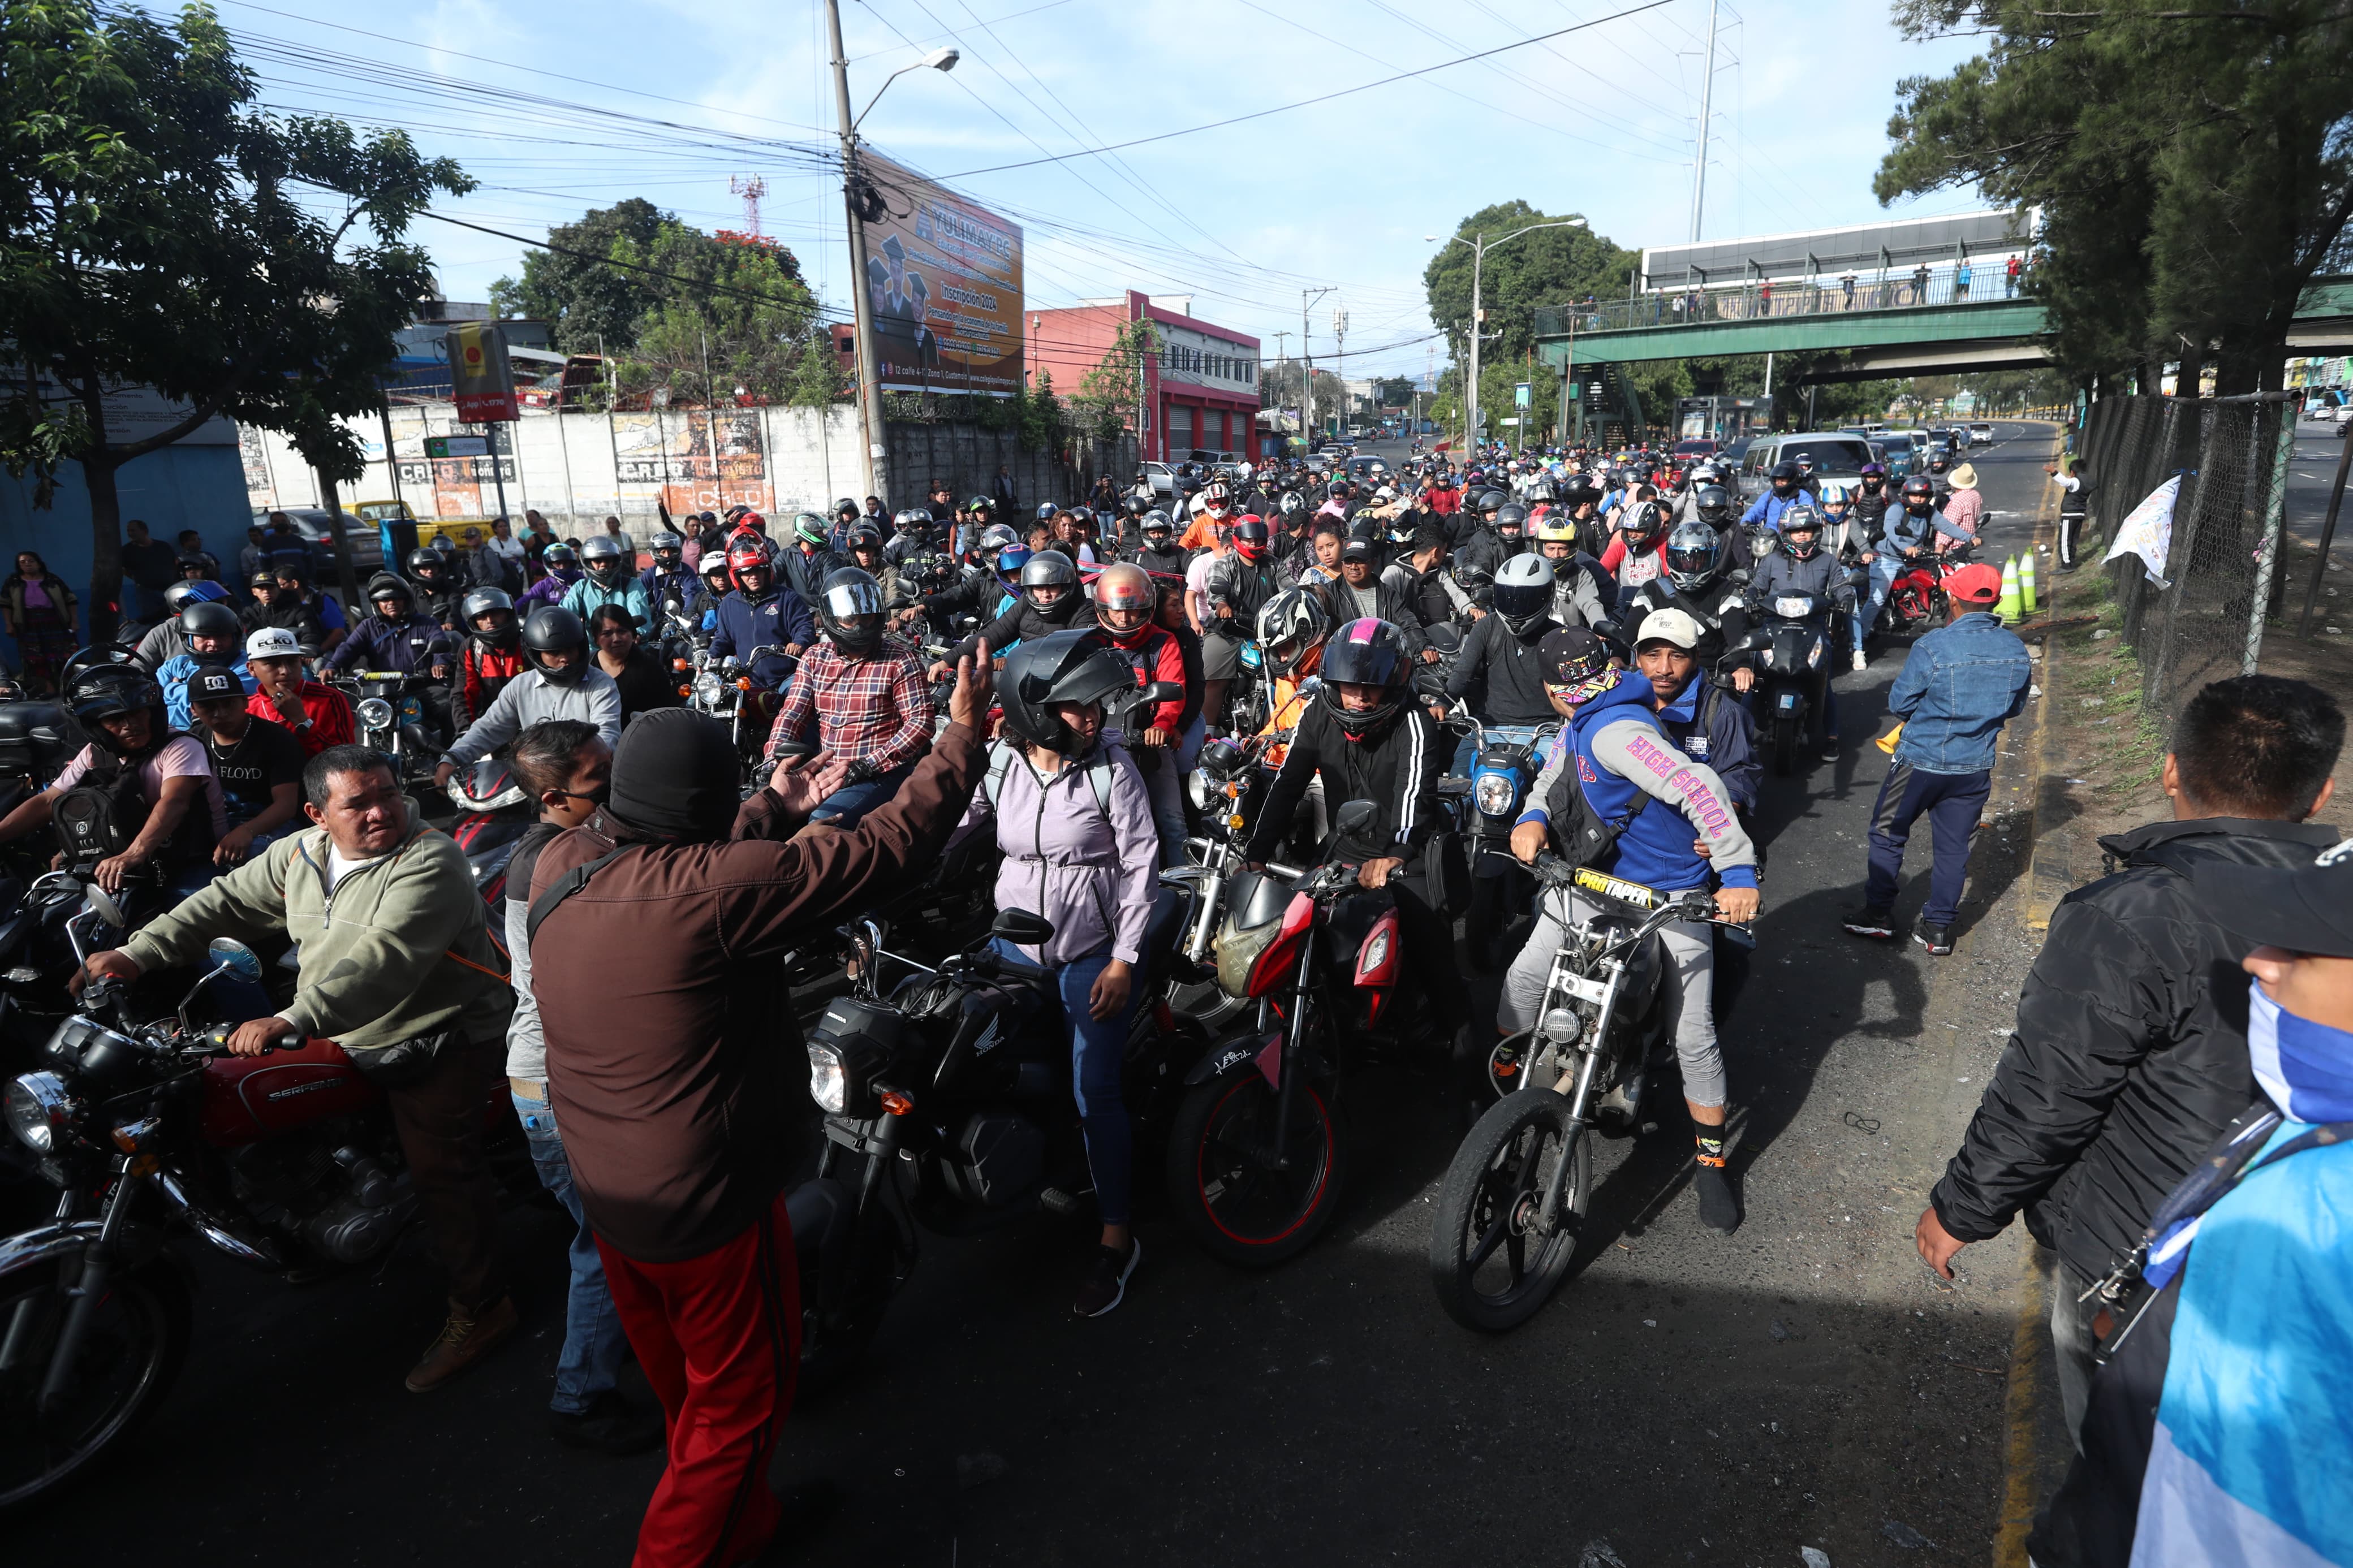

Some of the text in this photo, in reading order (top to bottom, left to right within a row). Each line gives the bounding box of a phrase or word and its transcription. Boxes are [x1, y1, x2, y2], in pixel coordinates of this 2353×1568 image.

[941, 281, 997, 312] Inscripción 2024
[928, 304, 952, 322] Pensando
[895, 366, 900, 374] 12
[219, 766, 262, 779] FLOYD
[1625, 735, 1677, 778] HIGH
[1672, 770, 1731, 838] SCHOOL
[1578, 871, 1649, 907] PROTAPER
[827, 1011, 847, 1023] HONDA
[976, 1036, 1005, 1057] HONDA
